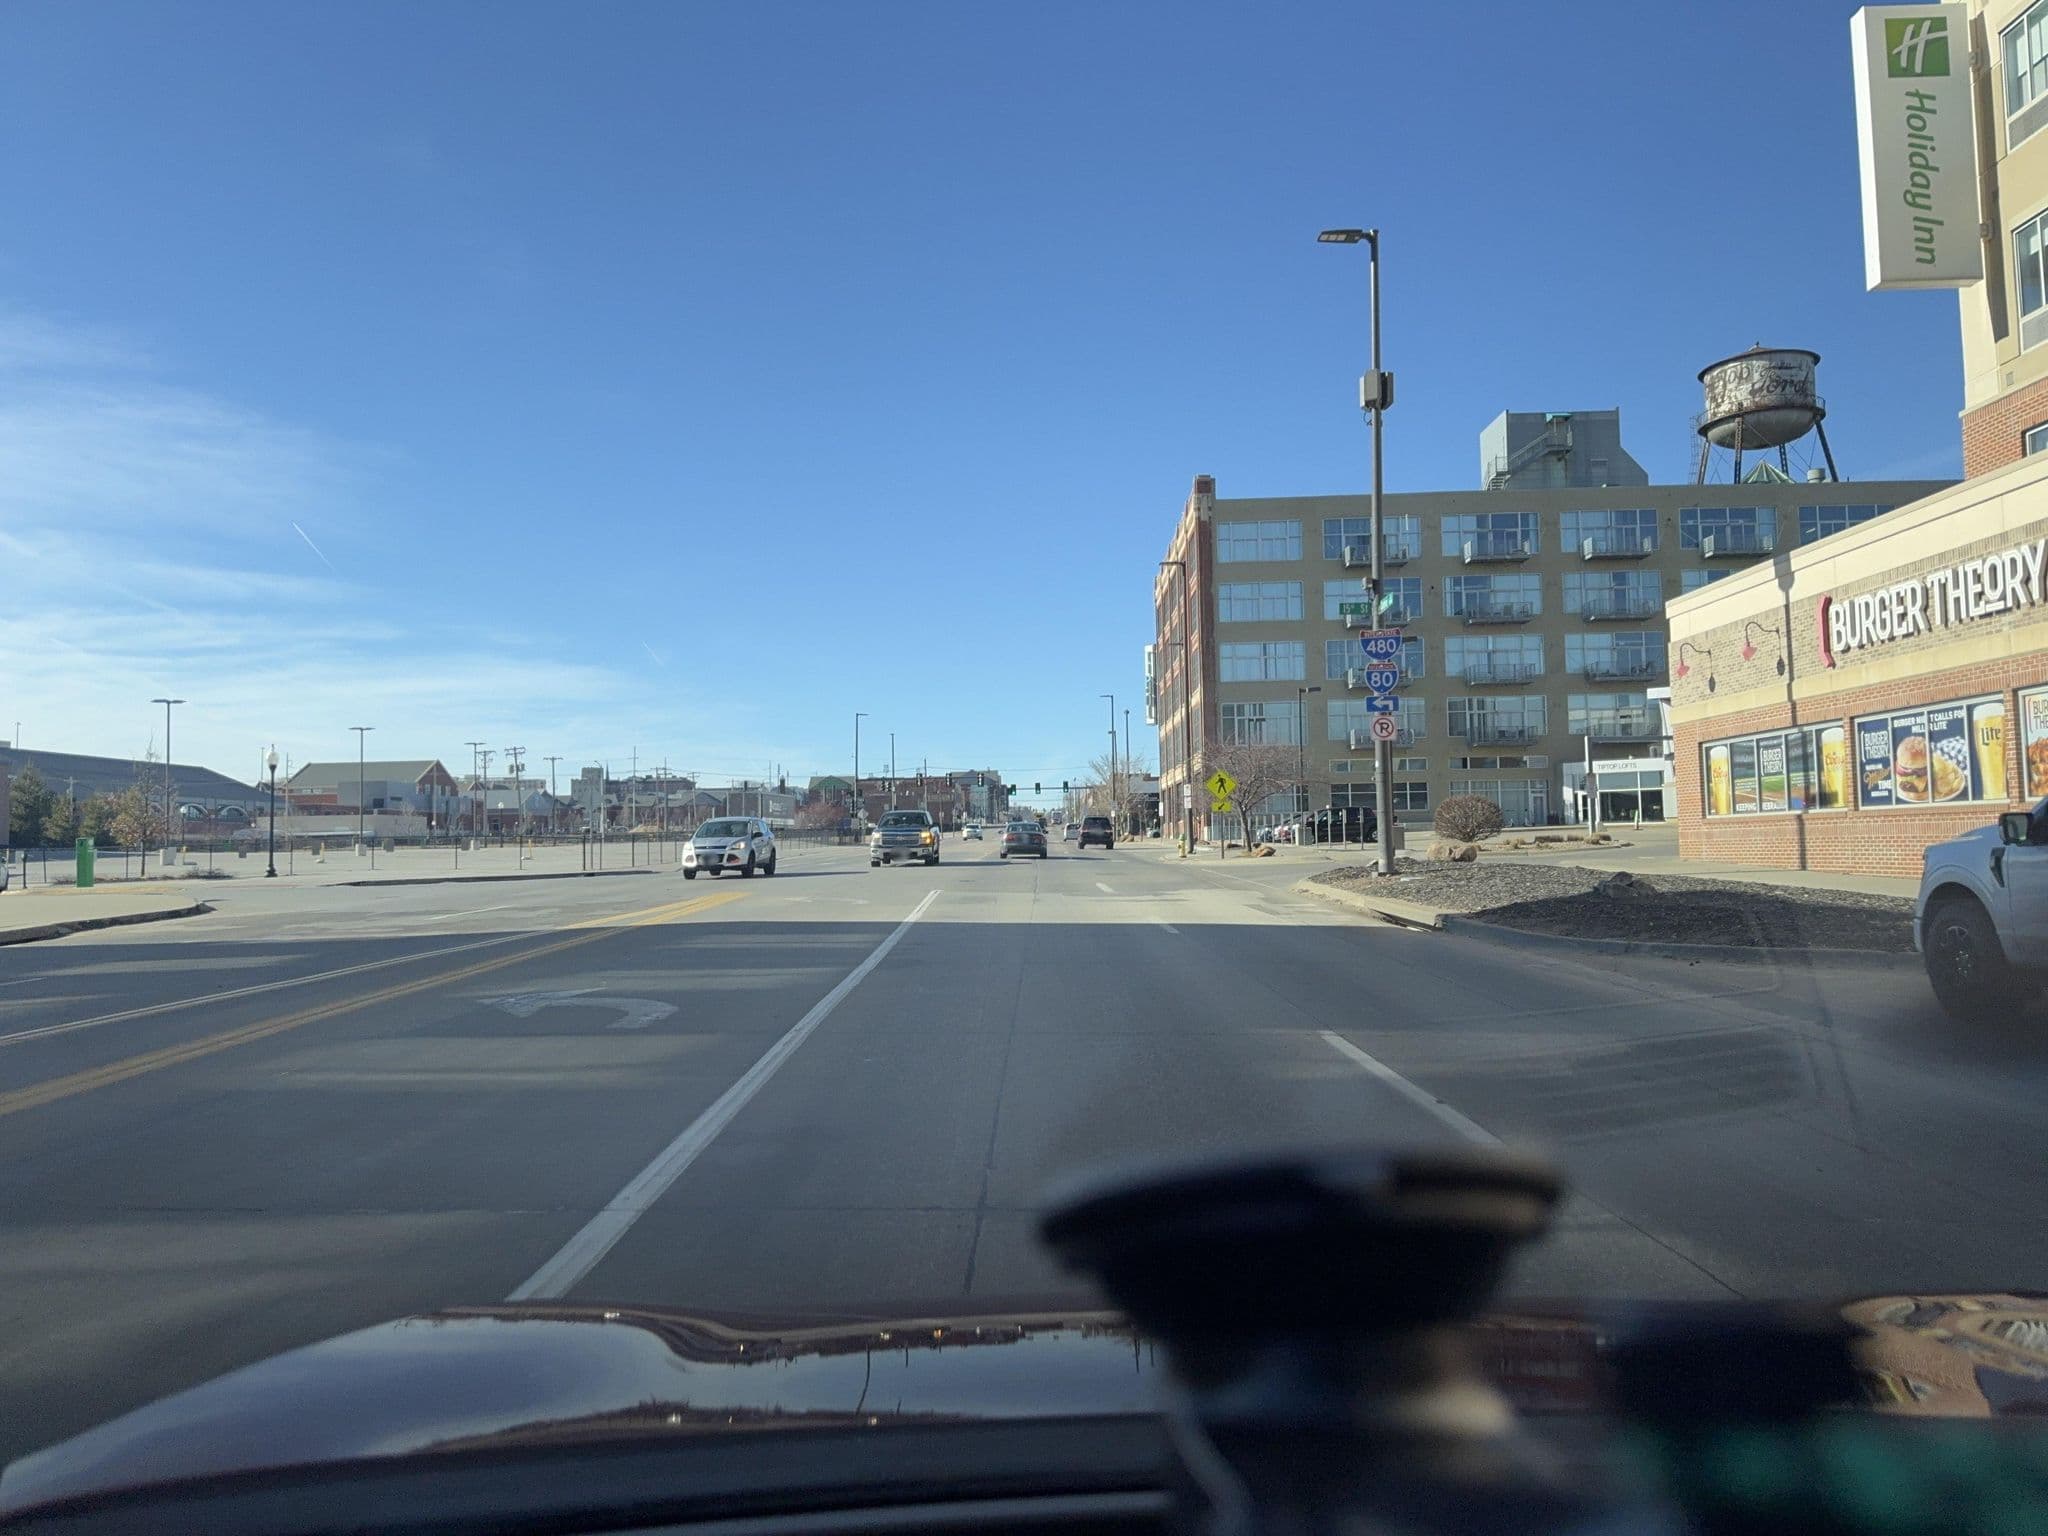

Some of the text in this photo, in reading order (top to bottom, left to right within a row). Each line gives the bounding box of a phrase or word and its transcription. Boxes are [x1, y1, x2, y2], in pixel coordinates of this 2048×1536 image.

[1903, 88, 1944, 265] Holiday Inn
[1830, 538, 2046, 652] BURGER THEORY
[1366, 639, 1397, 654] 480
[1370, 672, 1393, 687] 80
[1935, 711, 1953, 722] CALLS
[1934, 720, 1948, 730] LITE
[1864, 731, 1888, 746] BURGER
[1981, 727, 2001, 745] Lite
[1763, 748, 1782, 761] BURGER
[1865, 745, 1889, 760] THEORY
